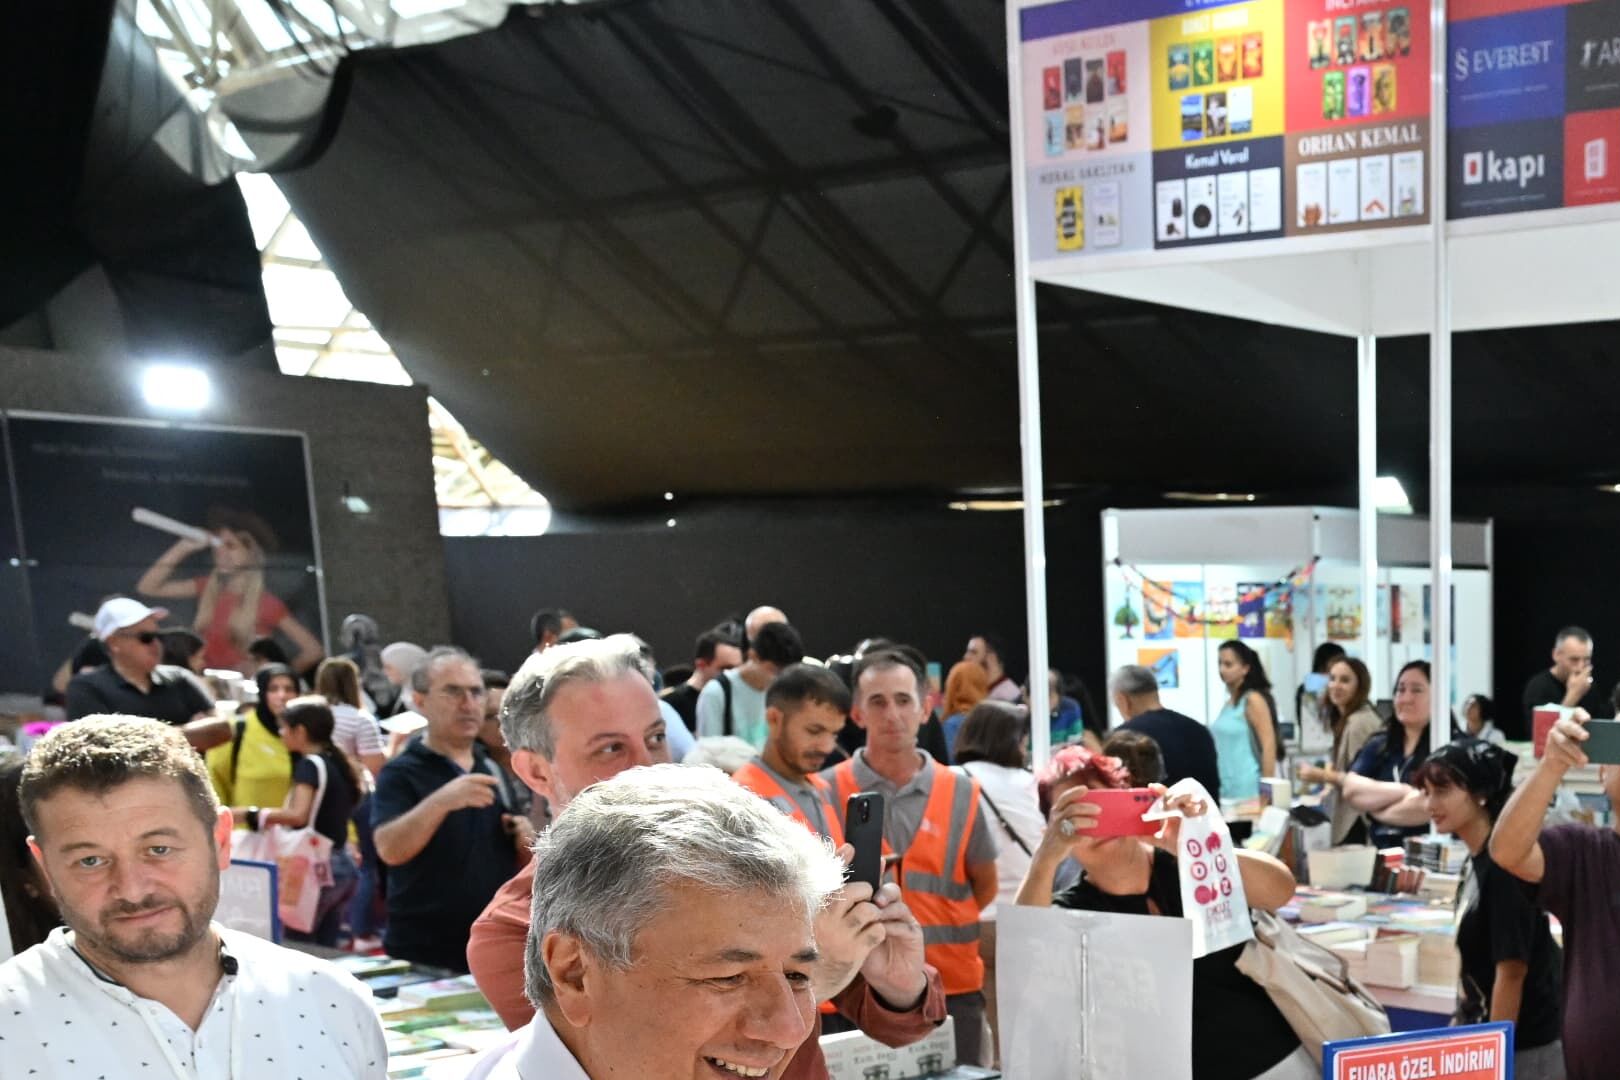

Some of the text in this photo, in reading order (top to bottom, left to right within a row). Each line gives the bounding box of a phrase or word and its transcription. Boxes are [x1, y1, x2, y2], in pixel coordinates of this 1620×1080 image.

[1473, 40, 1553, 73] EVEREST
[1298, 123, 1422, 157] ORHAN KEMAL
[1487, 150, 1545, 188] kapı
[1400, 1056, 1437, 1080] ÖZEL
[1440, 1045, 1495, 1075] İNDİRİM
